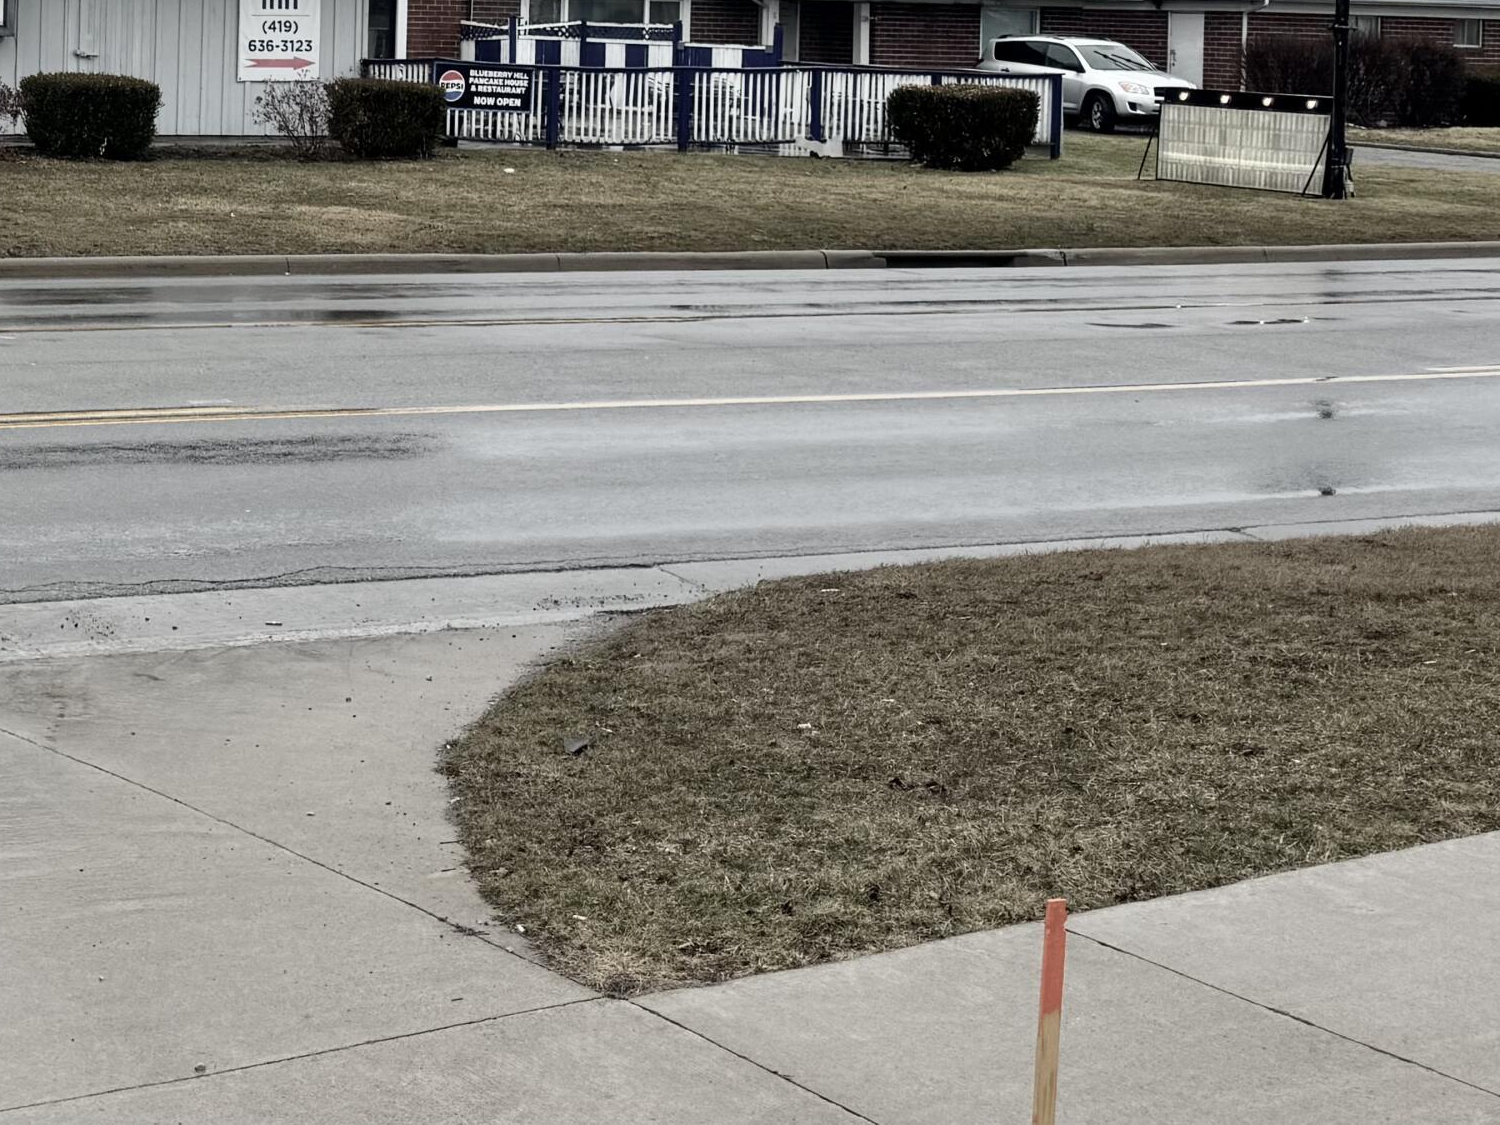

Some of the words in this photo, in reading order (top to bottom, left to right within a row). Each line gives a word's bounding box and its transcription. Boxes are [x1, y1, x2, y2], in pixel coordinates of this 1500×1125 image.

[262, 20, 299, 34] (419)
[248, 40, 313, 52] 636-3123
[469, 69, 512, 78] BLUEBERRY
[440, 82, 464, 90] PEPSI
[469, 77, 504, 85] PANCAKE
[504, 79, 529, 87] HOUSE
[477, 85, 526, 94] RESTAURANT
[473, 96, 495, 105] NOW
[496, 97, 521, 107] OPEN
